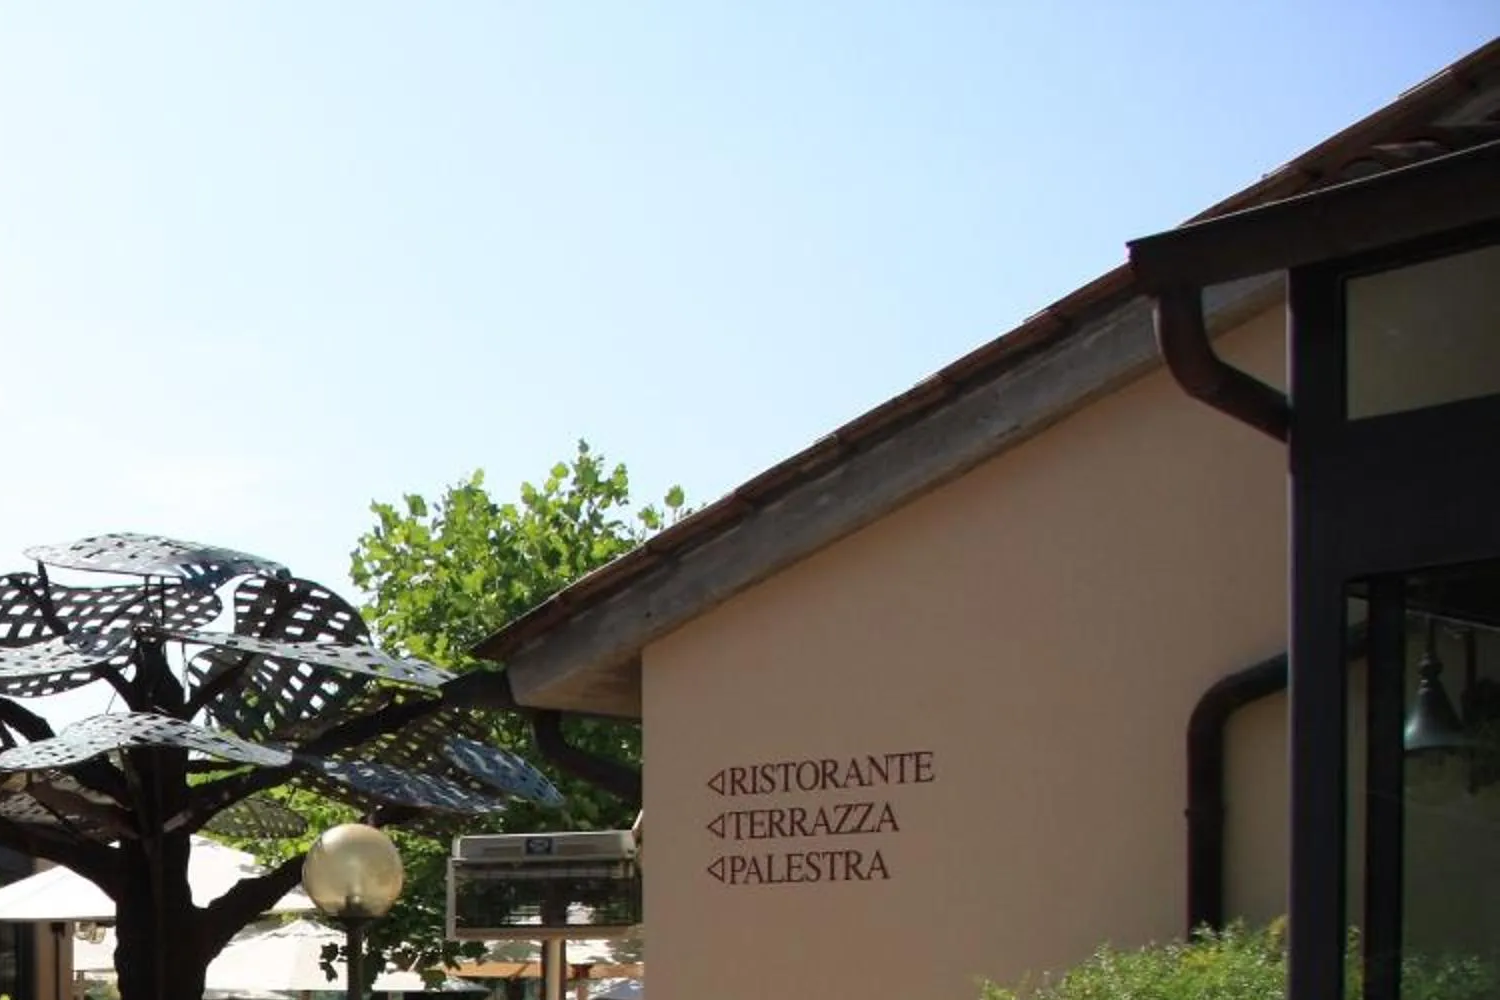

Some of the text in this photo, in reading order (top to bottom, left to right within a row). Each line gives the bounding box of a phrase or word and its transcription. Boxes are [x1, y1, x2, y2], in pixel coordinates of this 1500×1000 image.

[729, 751, 935, 795] RISTORANTE
[728, 801, 900, 840] TERRAZZA
[729, 850, 891, 884] PALESTRA
